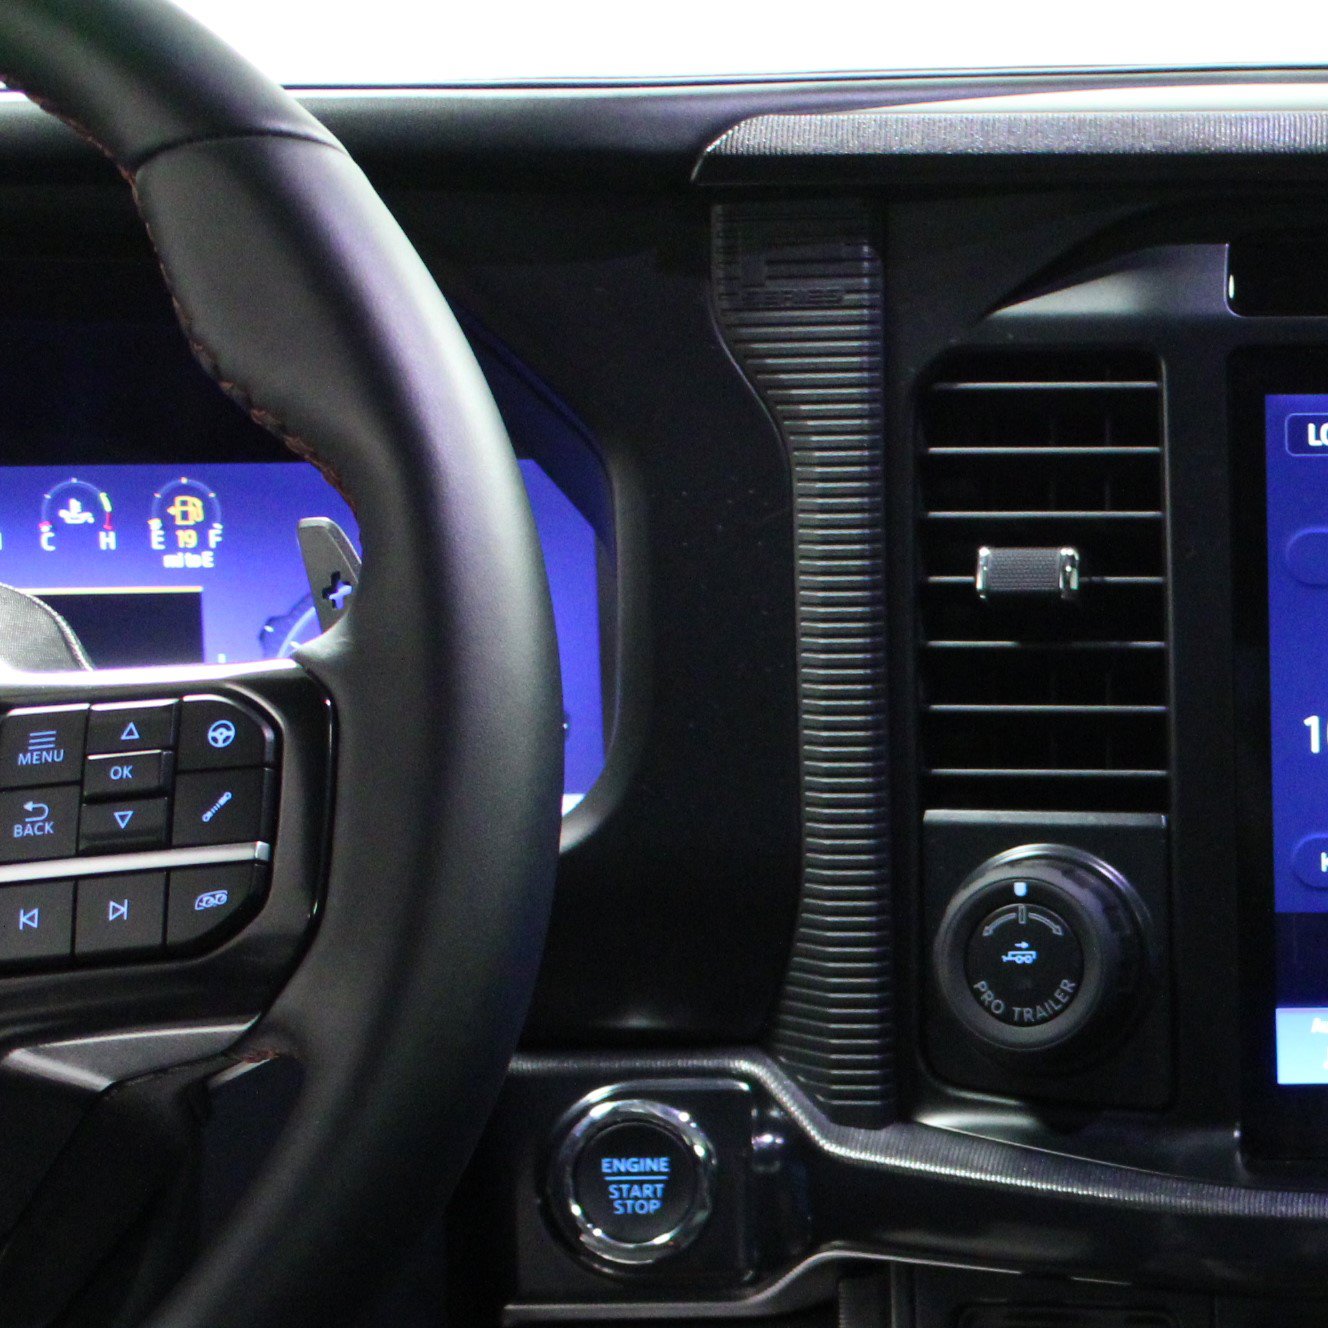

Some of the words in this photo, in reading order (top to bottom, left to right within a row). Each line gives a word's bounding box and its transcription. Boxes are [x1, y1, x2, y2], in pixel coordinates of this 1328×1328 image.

[40, 531, 56, 551] C
[99, 530, 117, 550] H
[151, 529, 166, 550] E
[175, 529, 198, 549] 19
[208, 529, 223, 549] F
[18, 749, 64, 765] MENU
[110, 765, 133, 780] OK
[13, 822, 54, 838] BACK
[973, 981, 1004, 1014] PRO
[1012, 979, 1076, 1022] TRAILER
[601, 1157, 670, 1173] ENGINE
[608, 1184, 665, 1199] START
[613, 1200, 661, 1215] STOP
